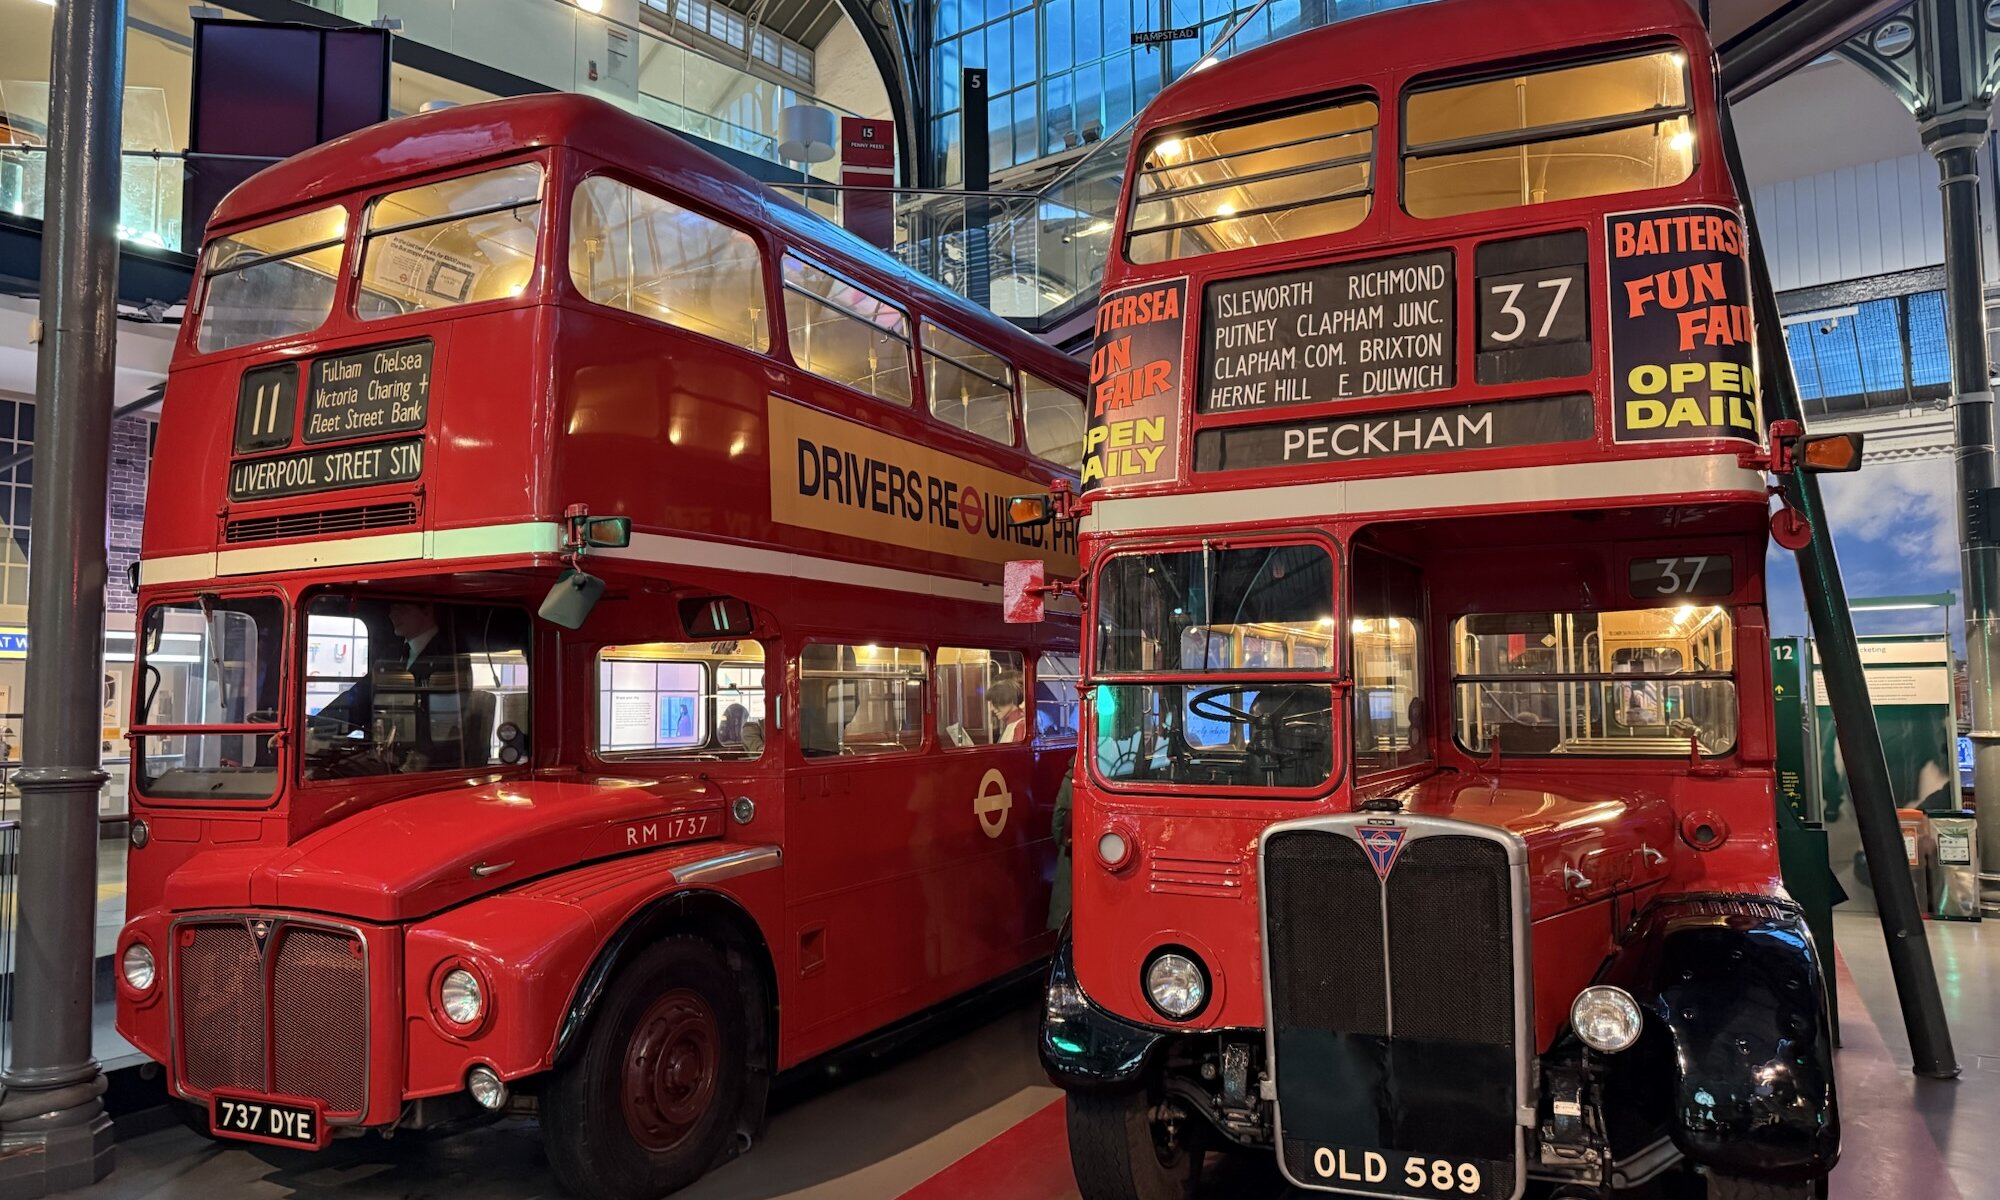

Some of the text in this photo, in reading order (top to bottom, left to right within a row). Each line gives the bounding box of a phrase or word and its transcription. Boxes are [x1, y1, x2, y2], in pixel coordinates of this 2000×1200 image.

[1135, 29, 1194, 43] HAMPSTEAD
[970, 74, 982, 89] 5
[863, 128, 874, 138] 15
[1218, 264, 1445, 319] ISLEWORTH RICHMOND
[1490, 277, 1572, 342] 37
[1623, 261, 1727, 319] FUN
[1215, 299, 1444, 350] PUTNEY CLAPHAM JUNC.
[322, 351, 422, 384] Fulham Chelsea
[1214, 332, 1442, 380] CLAPHAM COM. BRIXTON
[316, 387, 359, 410] Victoria
[368, 379, 412, 402] Charing
[1094, 359, 1174, 419] FAIR
[1210, 364, 1443, 409] HERNE HILL E. DULWICH
[252, 382, 281, 435] 11
[310, 400, 422, 435] Fleet Street Bank
[1283, 412, 1493, 461] PECKHAM
[235, 443, 422, 493] LIVERPOOL STREET STN
[798, 438, 924, 522] DRIVERS
[1081, 445, 1167, 487] AILY
[1655, 556, 1709, 594] 37
[710, 600, 729, 630] 11
[1773, 645, 1793, 660] 12
[627, 816, 708, 845] RM 1737
[222, 1102, 310, 1139] 737 DYE
[1314, 1147, 1481, 1195] OLD 589
